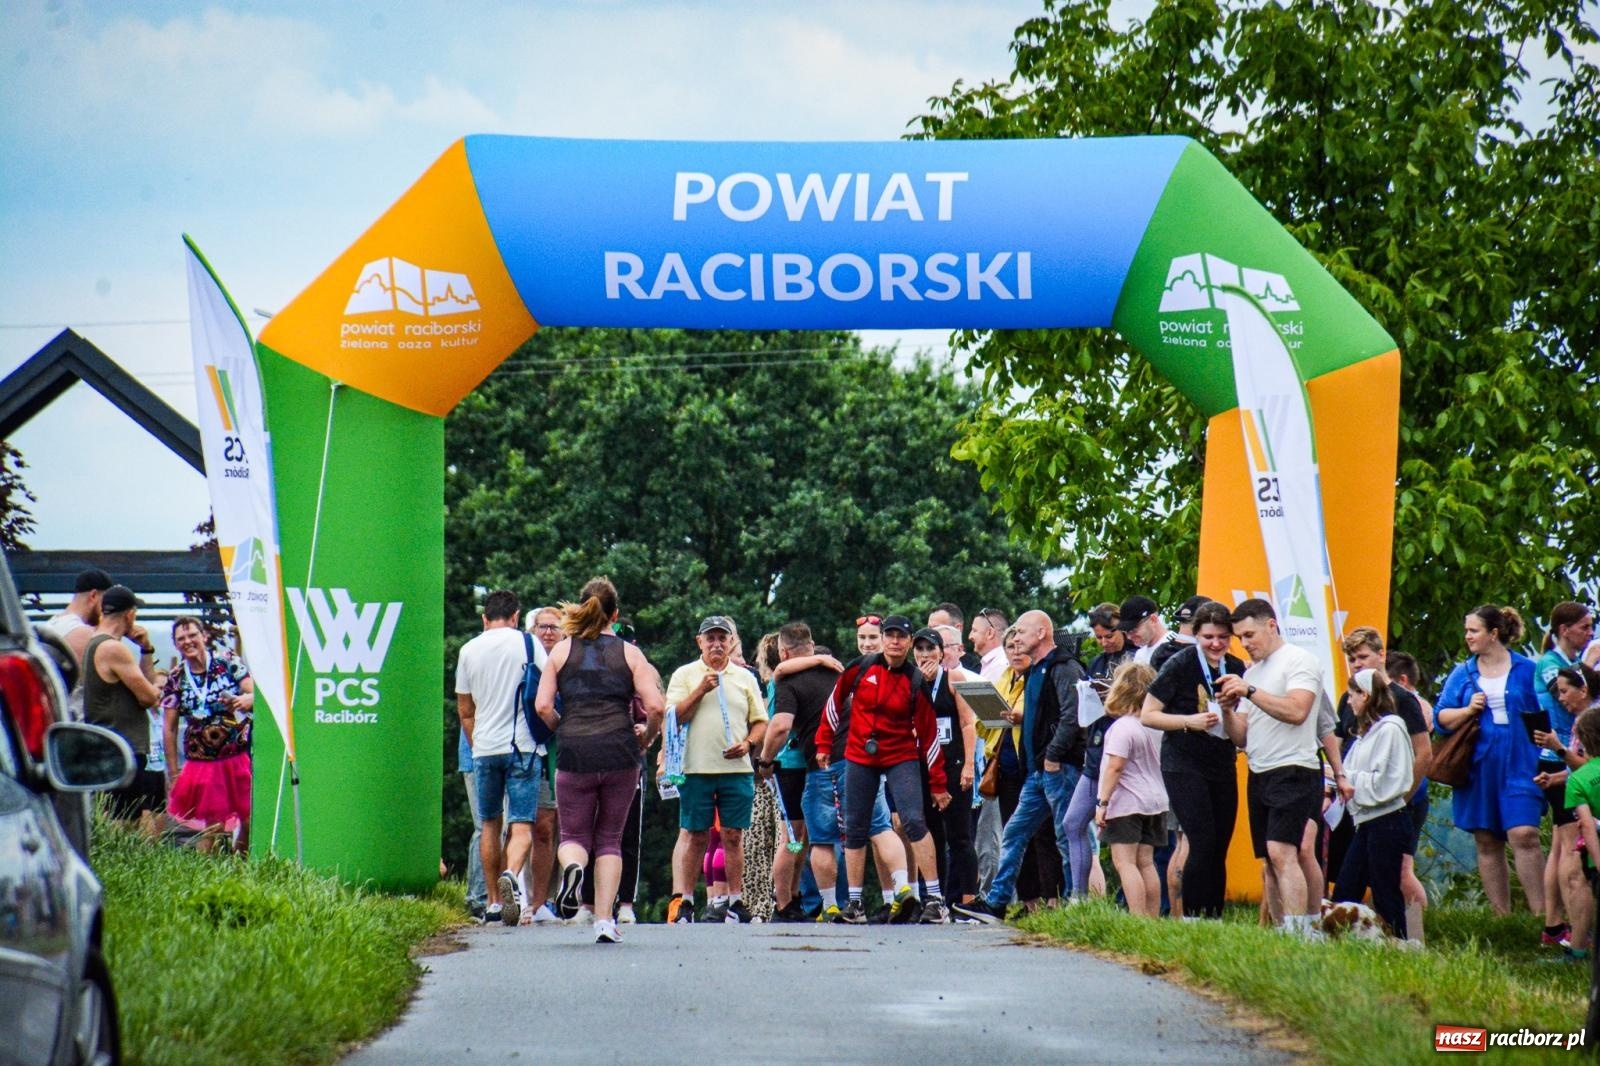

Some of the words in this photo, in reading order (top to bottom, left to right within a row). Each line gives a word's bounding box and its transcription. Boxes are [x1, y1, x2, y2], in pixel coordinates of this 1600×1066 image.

[673, 171, 969, 222] POWIAT
[604, 251, 1033, 302] RACIBORSKI
[341, 321, 395, 336] powiat
[404, 320, 482, 336] raciborski
[1160, 319, 1213, 334] powiat
[341, 339, 389, 349] zielona
[398, 340, 432, 349] oaza
[440, 337, 480, 348] kultur
[1162, 335, 1207, 348] zielona
[315, 677, 380, 707] PCS
[315, 709, 378, 724] Racibórz
